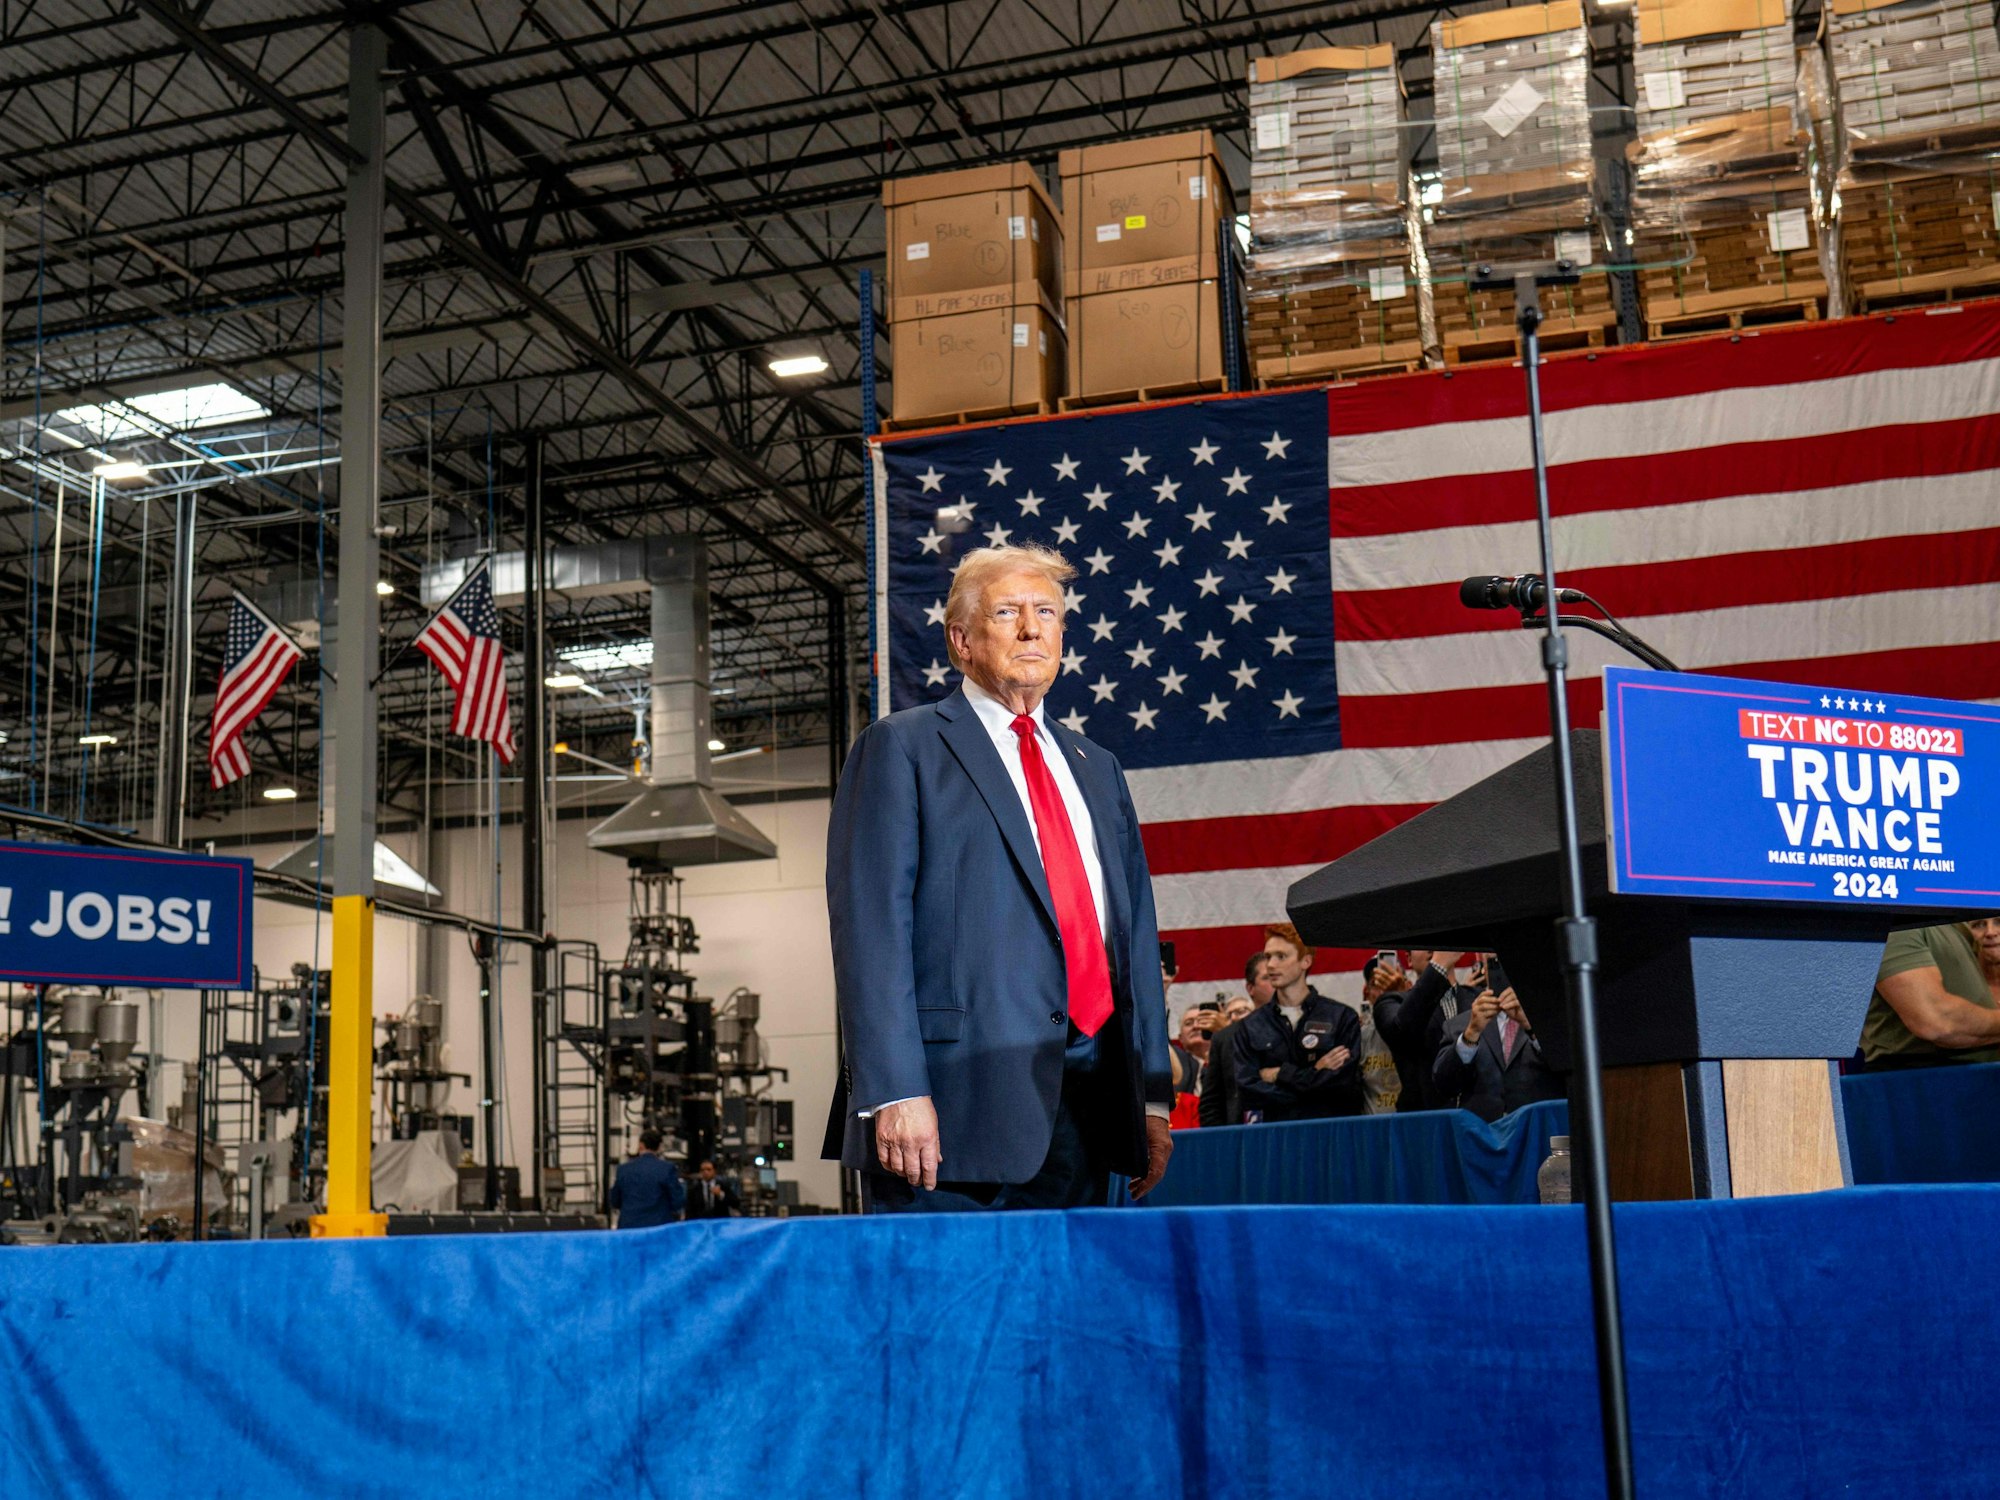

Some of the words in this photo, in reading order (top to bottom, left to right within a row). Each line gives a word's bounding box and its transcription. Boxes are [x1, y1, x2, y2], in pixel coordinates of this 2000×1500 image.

[1096, 271, 1113, 292] HL
[1118, 268, 1144, 286] PIPE
[915, 298, 934, 315] HL
[937, 296, 961, 313] PIPE
[1748, 712, 1808, 740] TEXT
[1814, 718, 1848, 744] NC
[1853, 721, 1884, 747] TO
[1890, 725, 1957, 754] 88022
[1748, 743, 1961, 810] TRUMP
[1776, 802, 1943, 854] VANCE
[1768, 850, 1806, 864] MAKE
[1809, 853, 1867, 868] AMERICA
[1869, 855, 1909, 870] GREAT
[1913, 858, 1955, 873] AGAIN!
[1832, 871, 1899, 899] 2024
[30, 890, 211, 945] JOBS!
